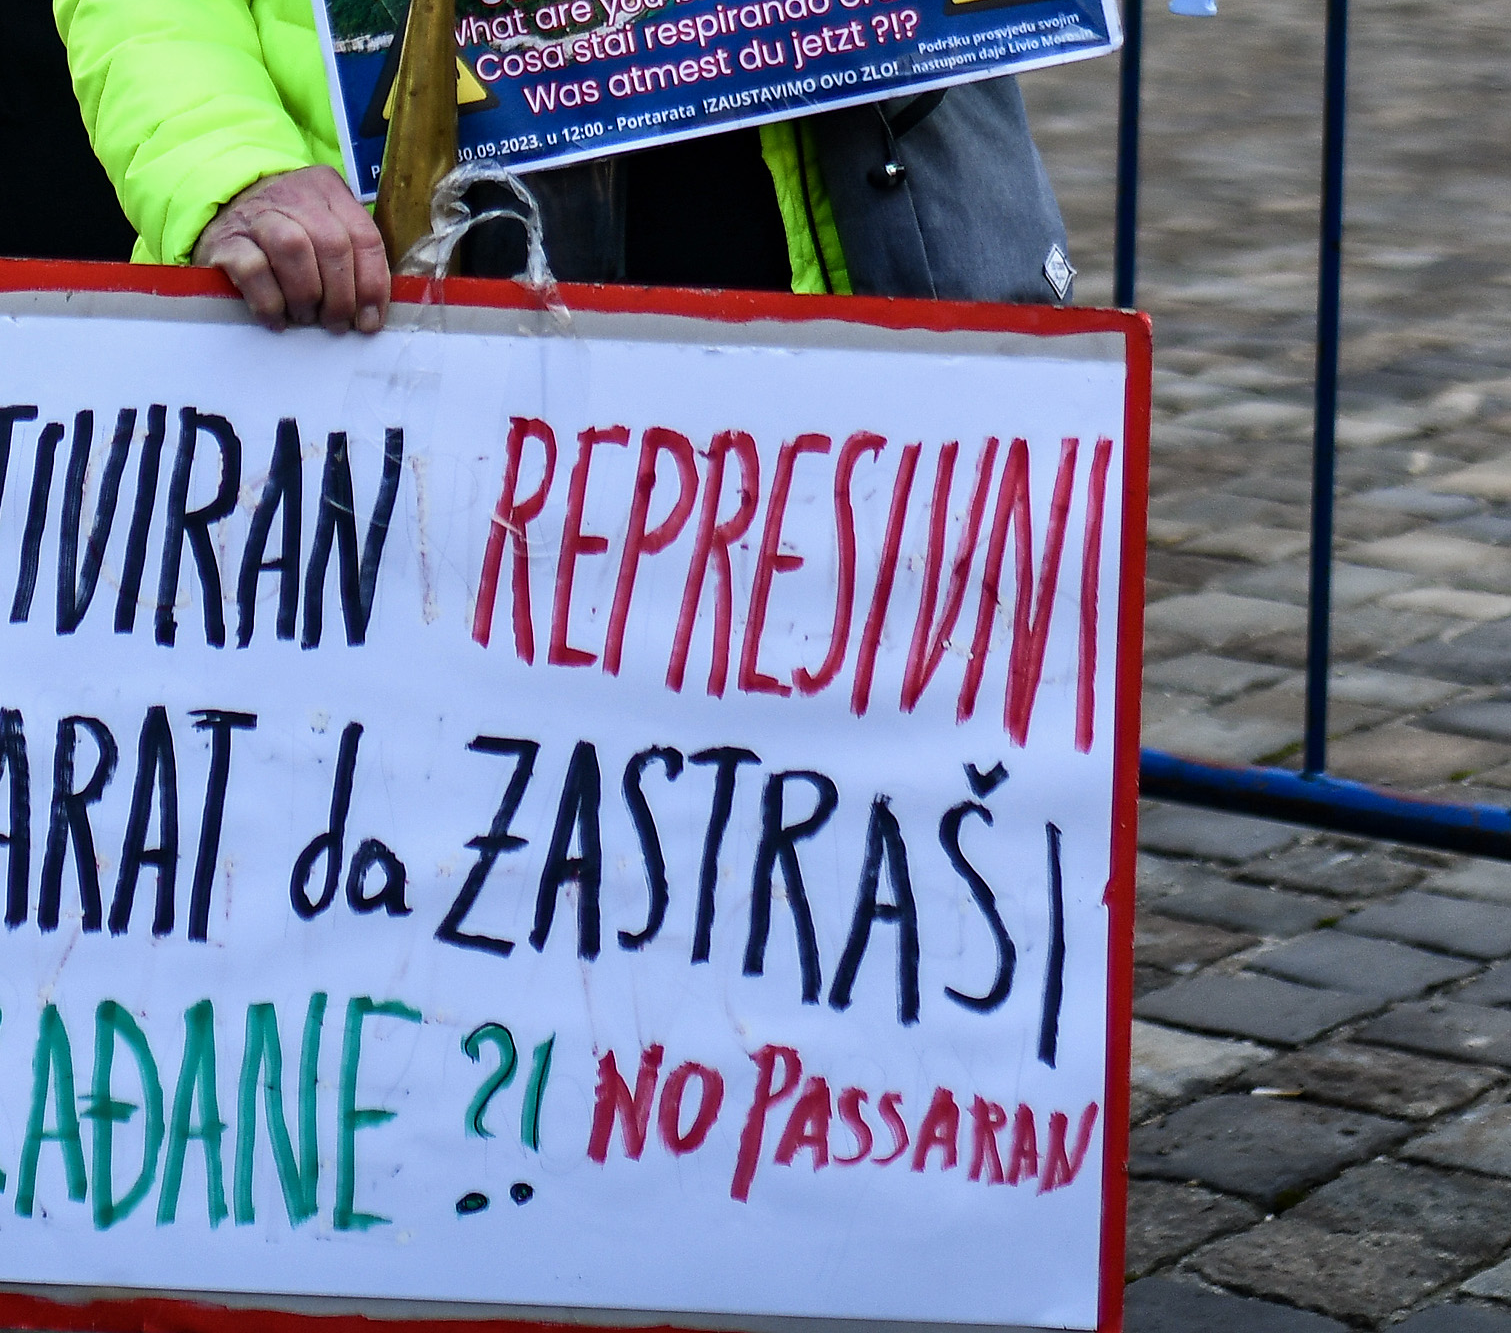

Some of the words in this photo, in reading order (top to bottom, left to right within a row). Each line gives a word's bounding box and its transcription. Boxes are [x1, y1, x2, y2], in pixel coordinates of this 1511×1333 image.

[476, 42, 565, 82] Cosa
[573, 25, 635, 62] stai
[535, 0, 592, 31] are
[912, 52, 977, 74] nastupom
[1008, 39, 1039, 54] Livio
[973, 21, 1036, 46] prosvjedu
[1038, 12, 1080, 30] svojim
[523, 79, 600, 114] Was
[608, 49, 731, 98] atmest
[740, 36, 785, 71] du
[792, 20, 865, 69] jetzt
[871, 10, 919, 43] ?!?
[547, 132, 558, 145] u
[562, 121, 604, 144] 12:00
[617, 105, 696, 131] Portarata
[820, 70, 857, 88] OVO
[860, 61, 899, 81] ZLO!
[466, 417, 1113, 758] REPRESIVNI
[290, 721, 413, 922] da
[434, 735, 1066, 1069] ZASTRAŠI
[587, 1043, 724, 1165] NO
